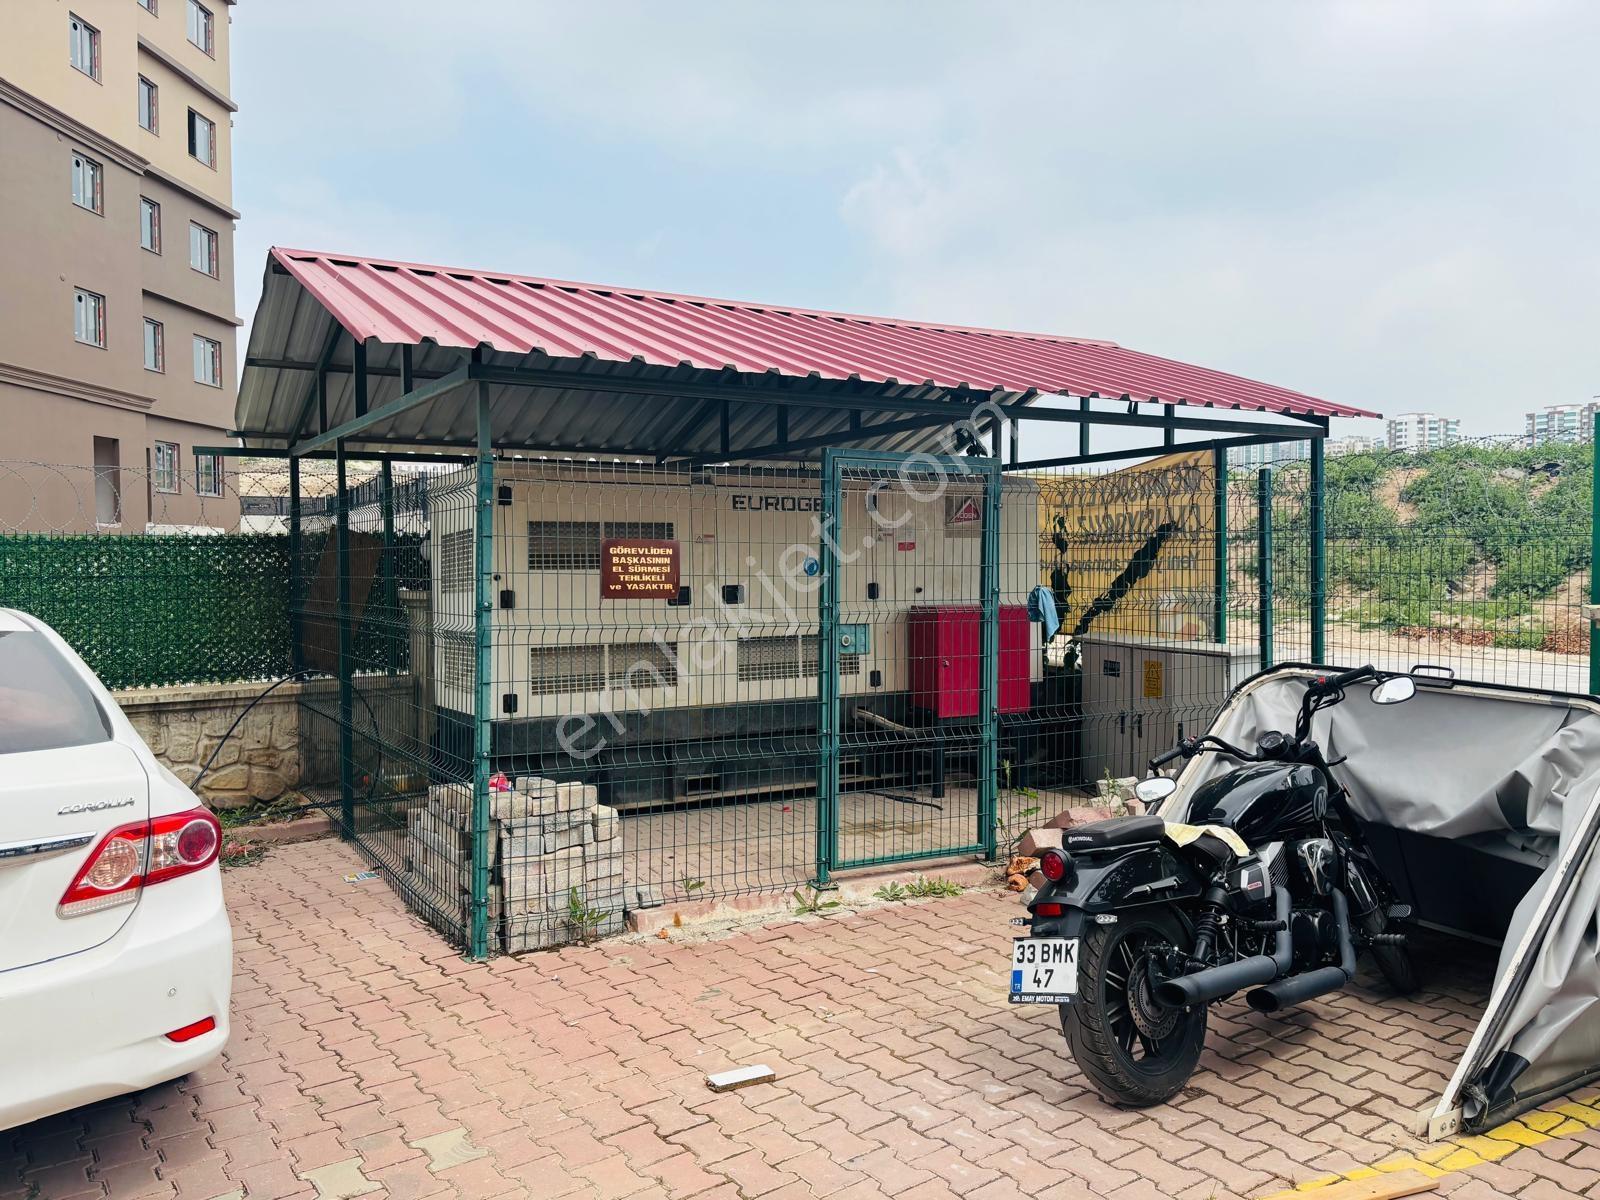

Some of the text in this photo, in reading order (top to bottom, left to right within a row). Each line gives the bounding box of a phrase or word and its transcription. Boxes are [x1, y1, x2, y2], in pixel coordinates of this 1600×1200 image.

[732, 495, 824, 512] EUROGE
[609, 545, 673, 555] GÖREVLİDEN
[612, 556, 671, 565] BAŞKASININ
[628, 565, 671, 573] SÜRMESİ
[619, 573, 665, 581] TEHLİKELİ
[57, 798, 135, 816] COROLLA
[1016, 943, 1075, 964] 33 BMK
[1032, 968, 1055, 988] 47
